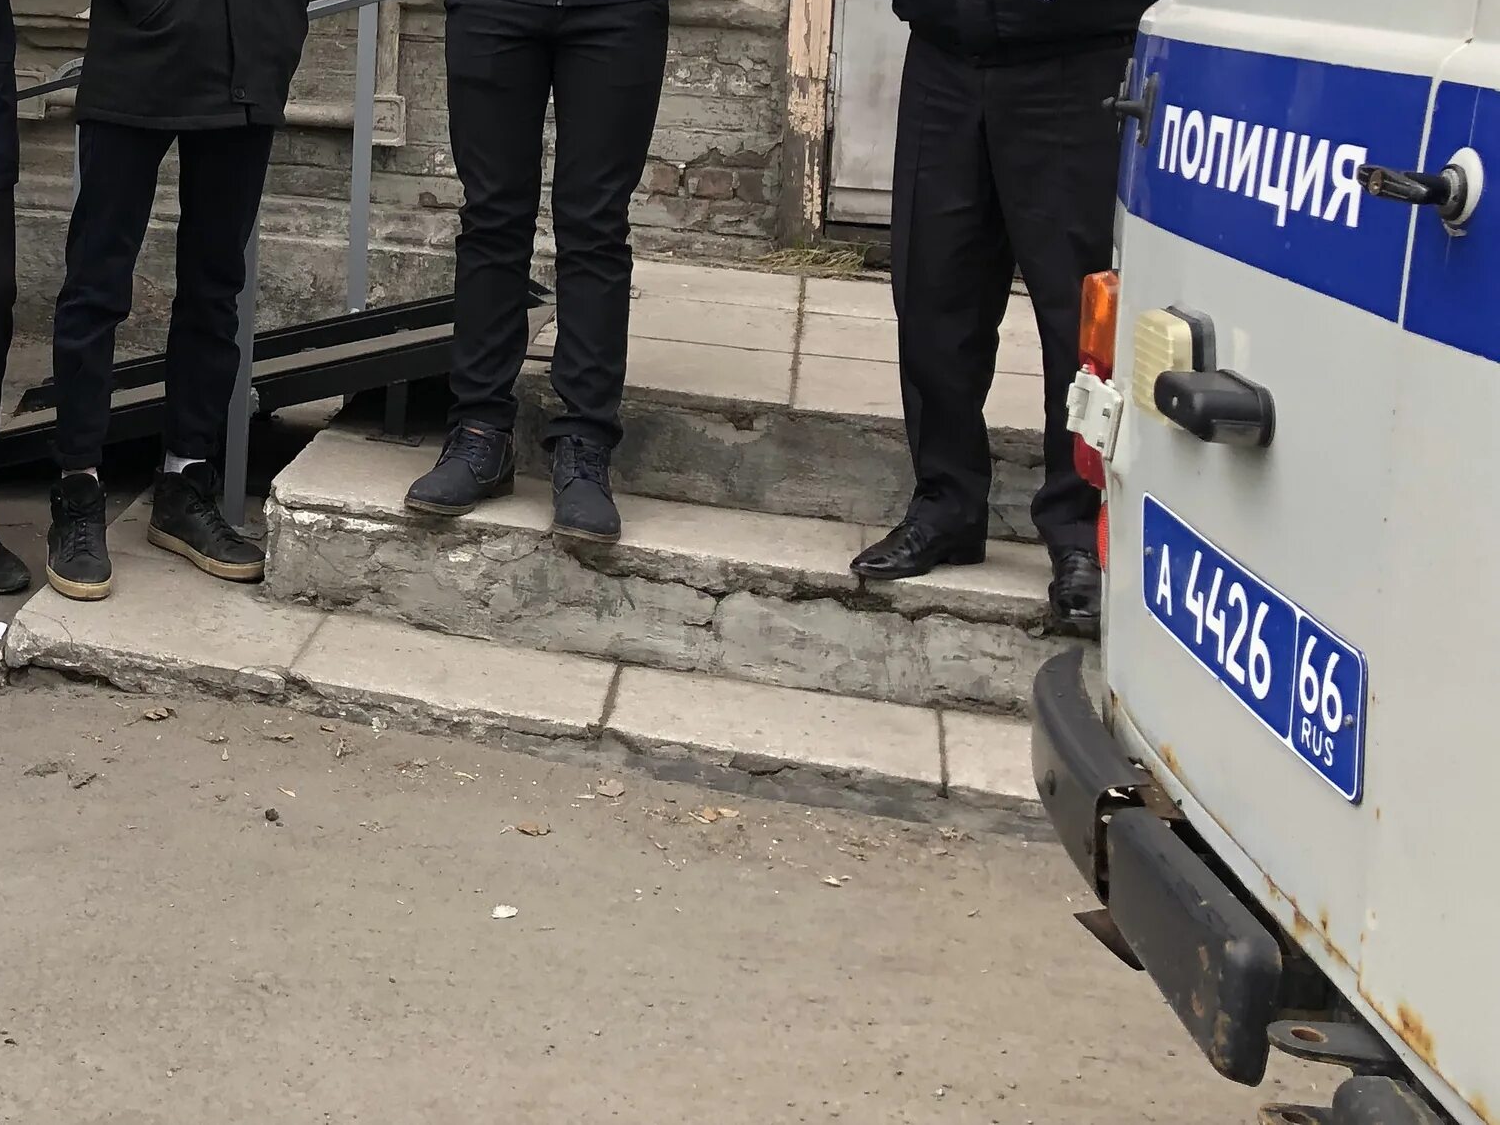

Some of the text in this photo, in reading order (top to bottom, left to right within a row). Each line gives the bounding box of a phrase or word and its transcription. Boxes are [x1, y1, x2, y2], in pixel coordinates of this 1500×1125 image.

[1158, 103, 1369, 228] ПОЛИЦИЯ
[1185, 550, 1272, 700] 4426
[1299, 635, 1343, 733] 66
[1300, 717, 1334, 767] RUS
